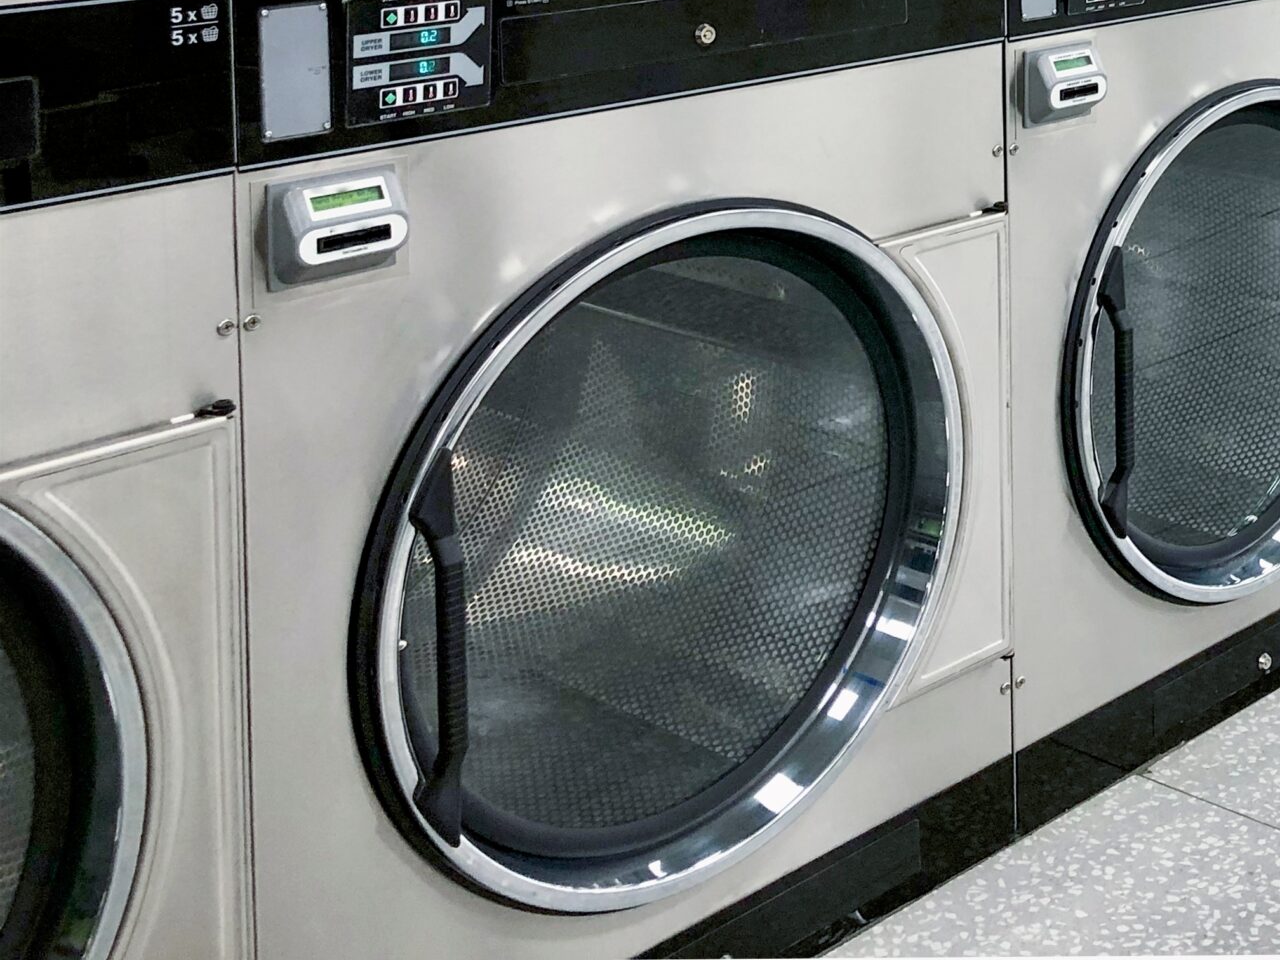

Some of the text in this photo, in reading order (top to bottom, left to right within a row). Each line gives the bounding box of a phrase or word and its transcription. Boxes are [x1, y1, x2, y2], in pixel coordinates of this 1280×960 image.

[170, 6, 198, 24] 5 x
[171, 29, 199, 46] 5 x
